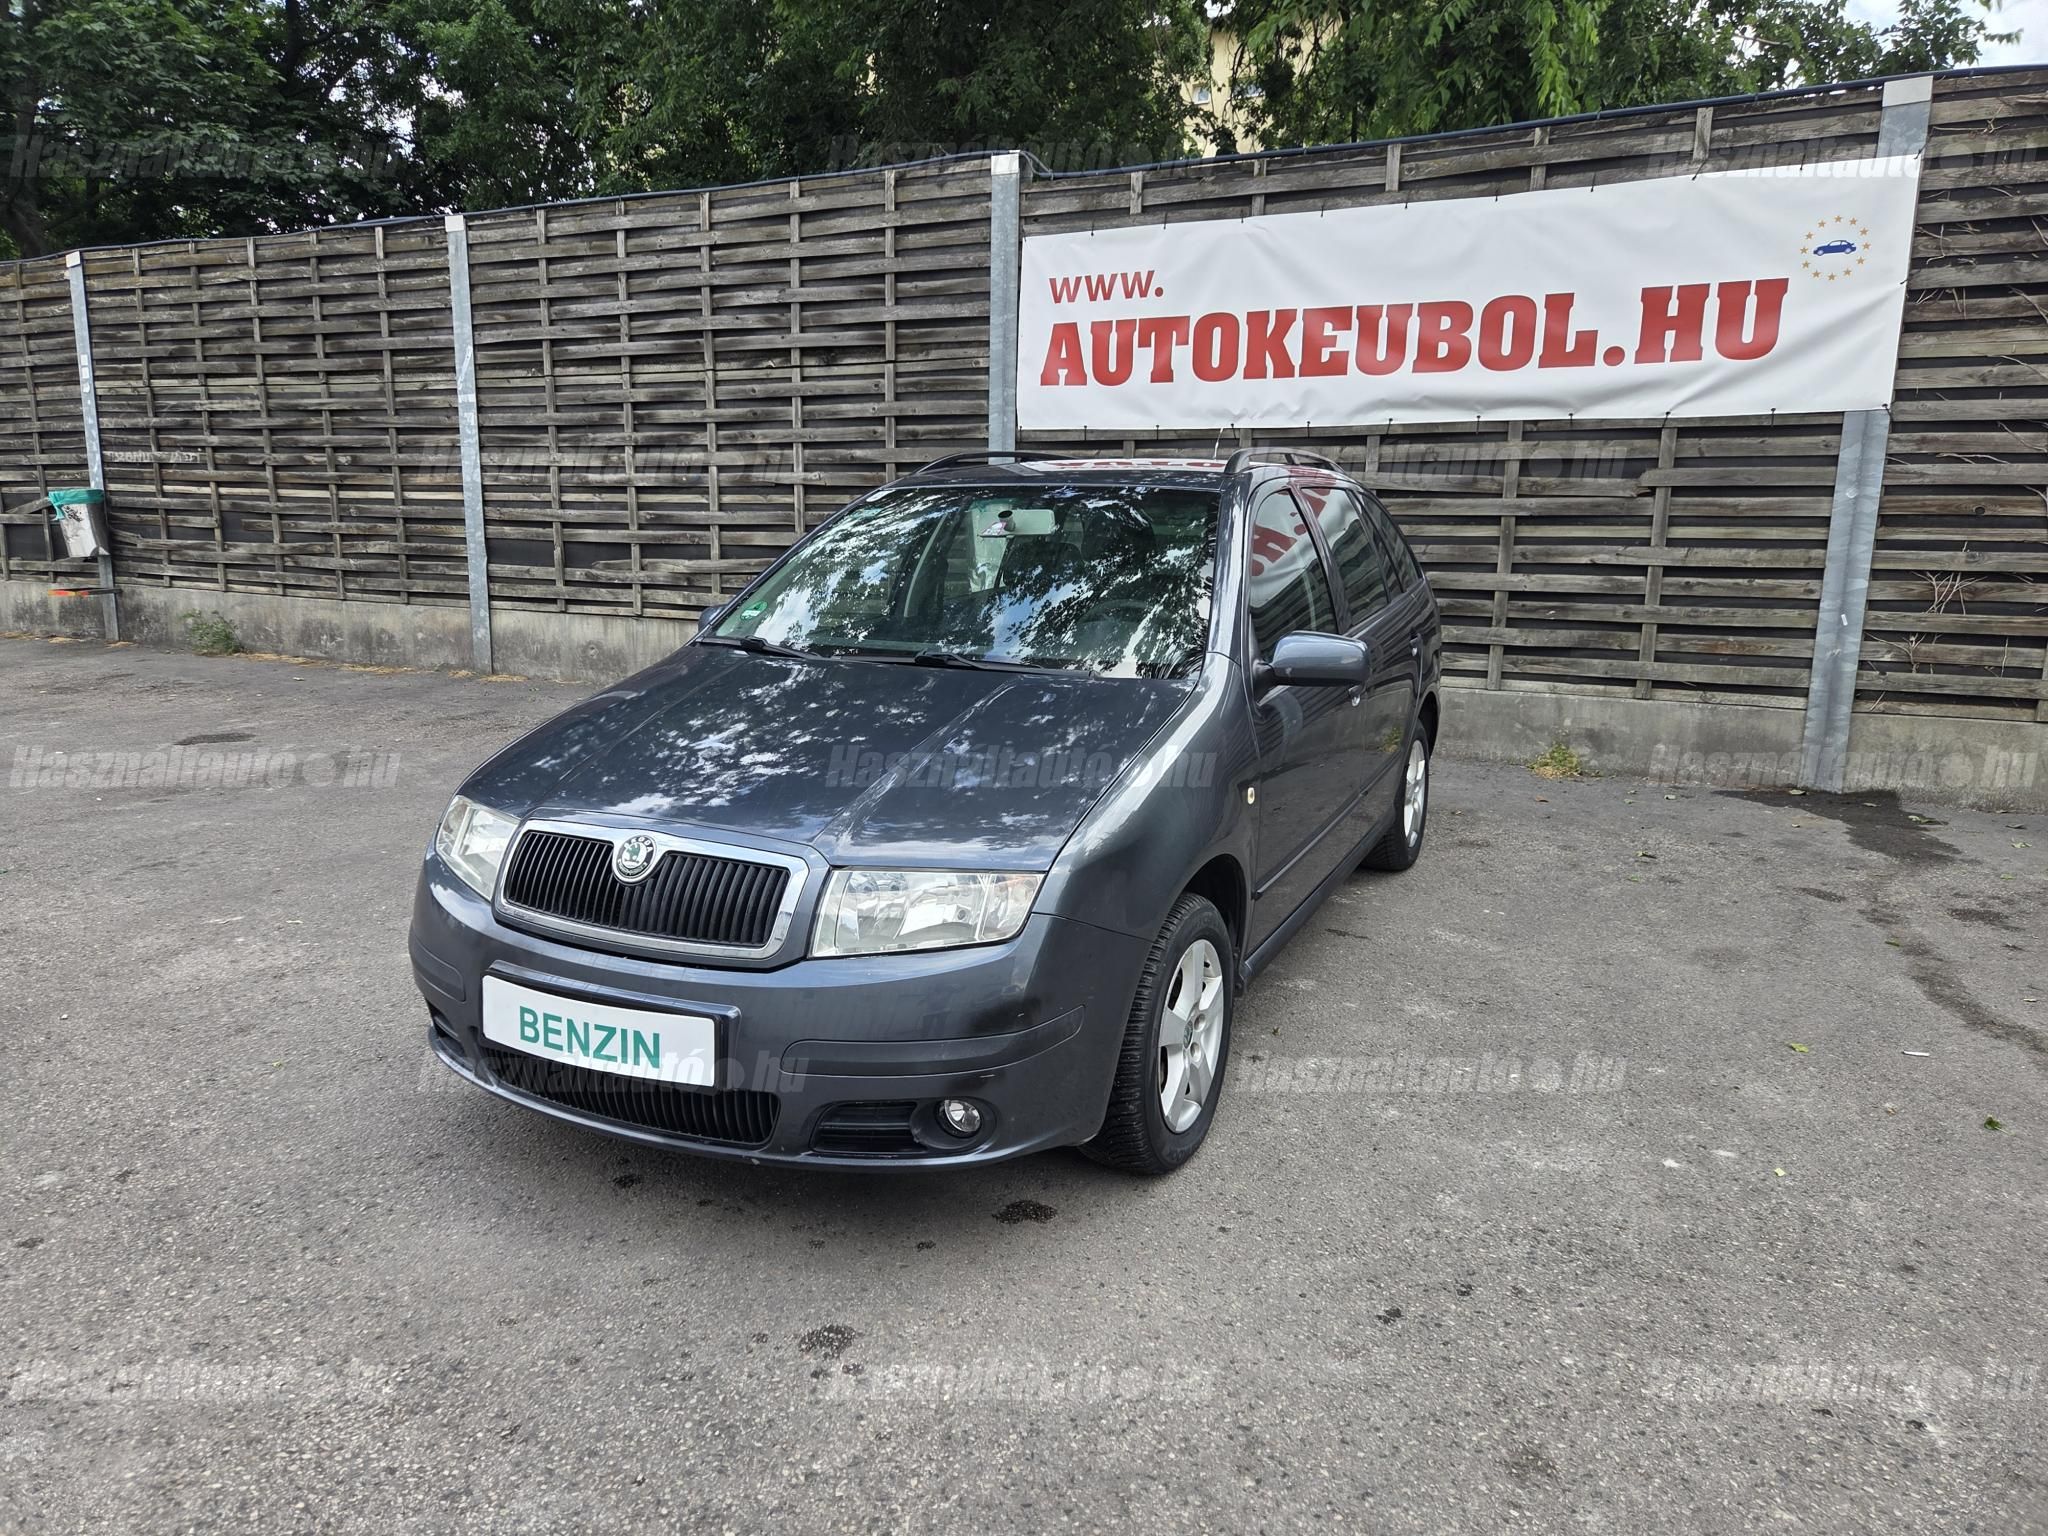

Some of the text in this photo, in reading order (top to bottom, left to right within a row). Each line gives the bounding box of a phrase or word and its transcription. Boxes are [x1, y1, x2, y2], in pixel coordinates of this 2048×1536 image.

[1048, 270, 1164, 304] www.
[1040, 278, 1789, 386] AUTOKEUBOL.HU
[519, 1006, 660, 1069] BENZIN
